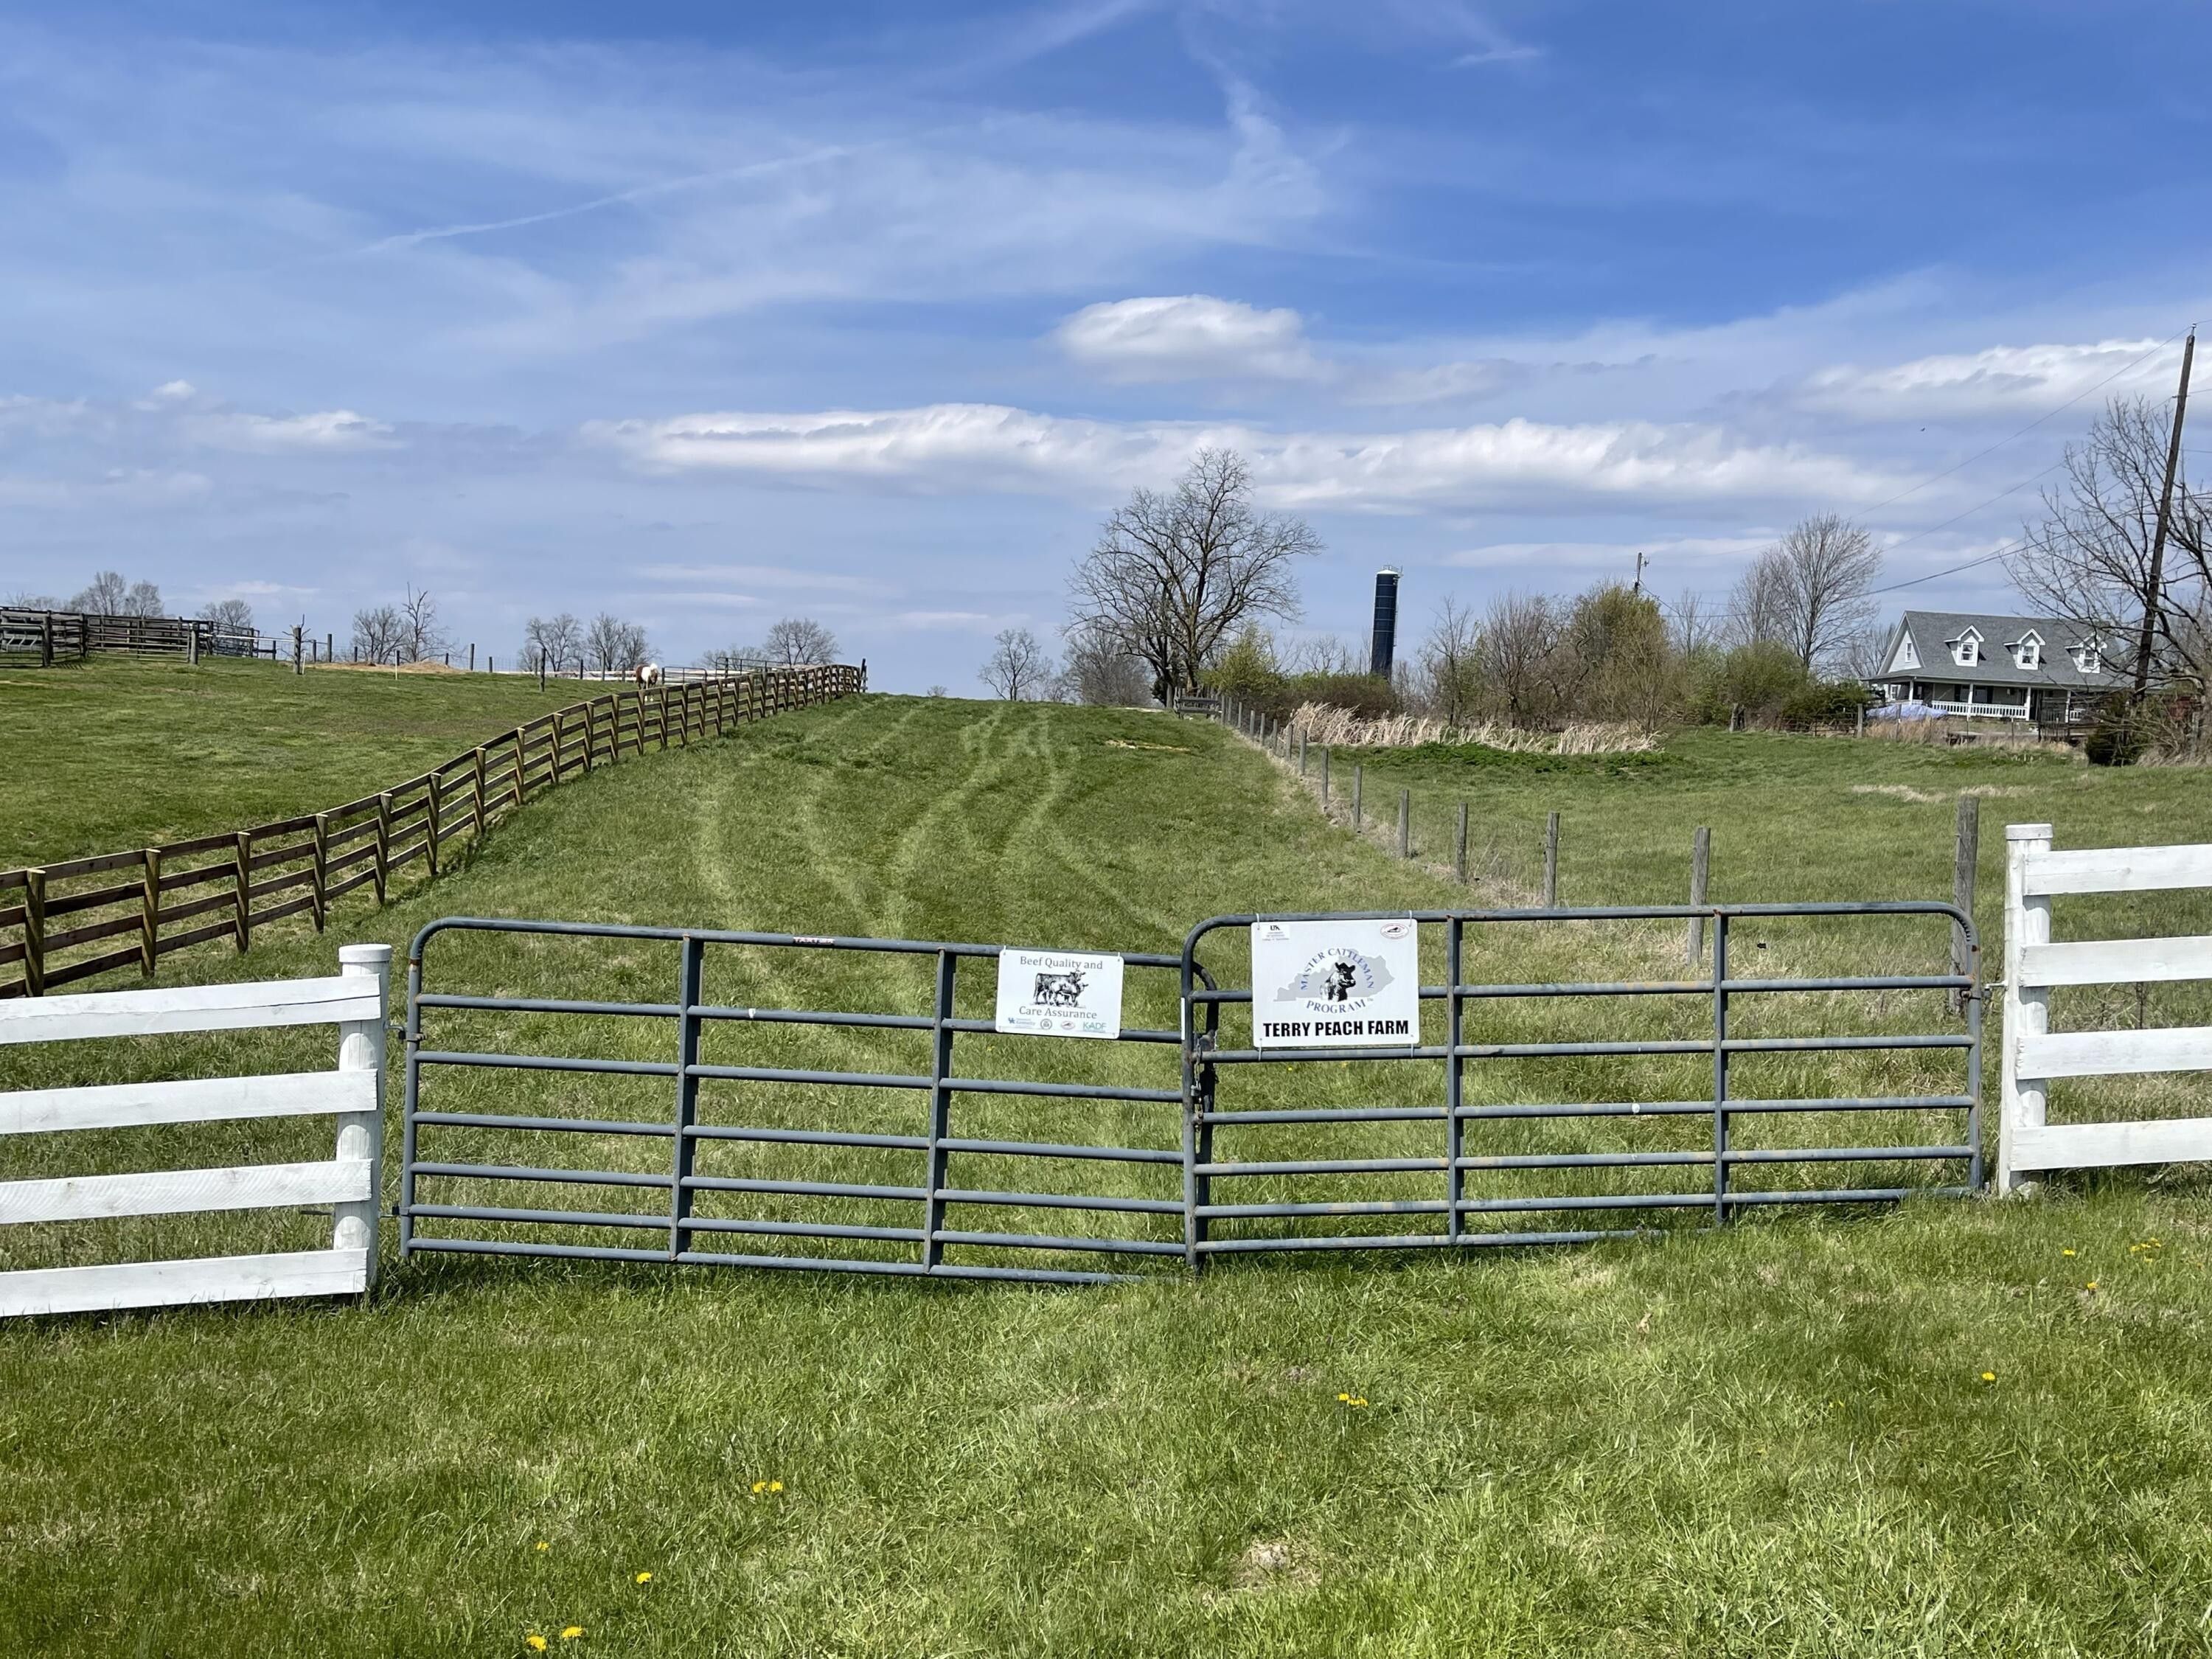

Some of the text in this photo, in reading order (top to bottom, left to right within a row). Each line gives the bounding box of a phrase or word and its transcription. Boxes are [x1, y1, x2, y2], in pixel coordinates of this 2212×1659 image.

[1020, 956, 1103, 970] Beef Quality and
[1301, 948, 1374, 990] MASTER CATTLEMAN
[1019, 1006, 1097, 1019] Care Assurance
[1306, 999, 1366, 1014] PROGRAM
[1263, 1020, 1408, 1037] TERRY PEACH FARM
